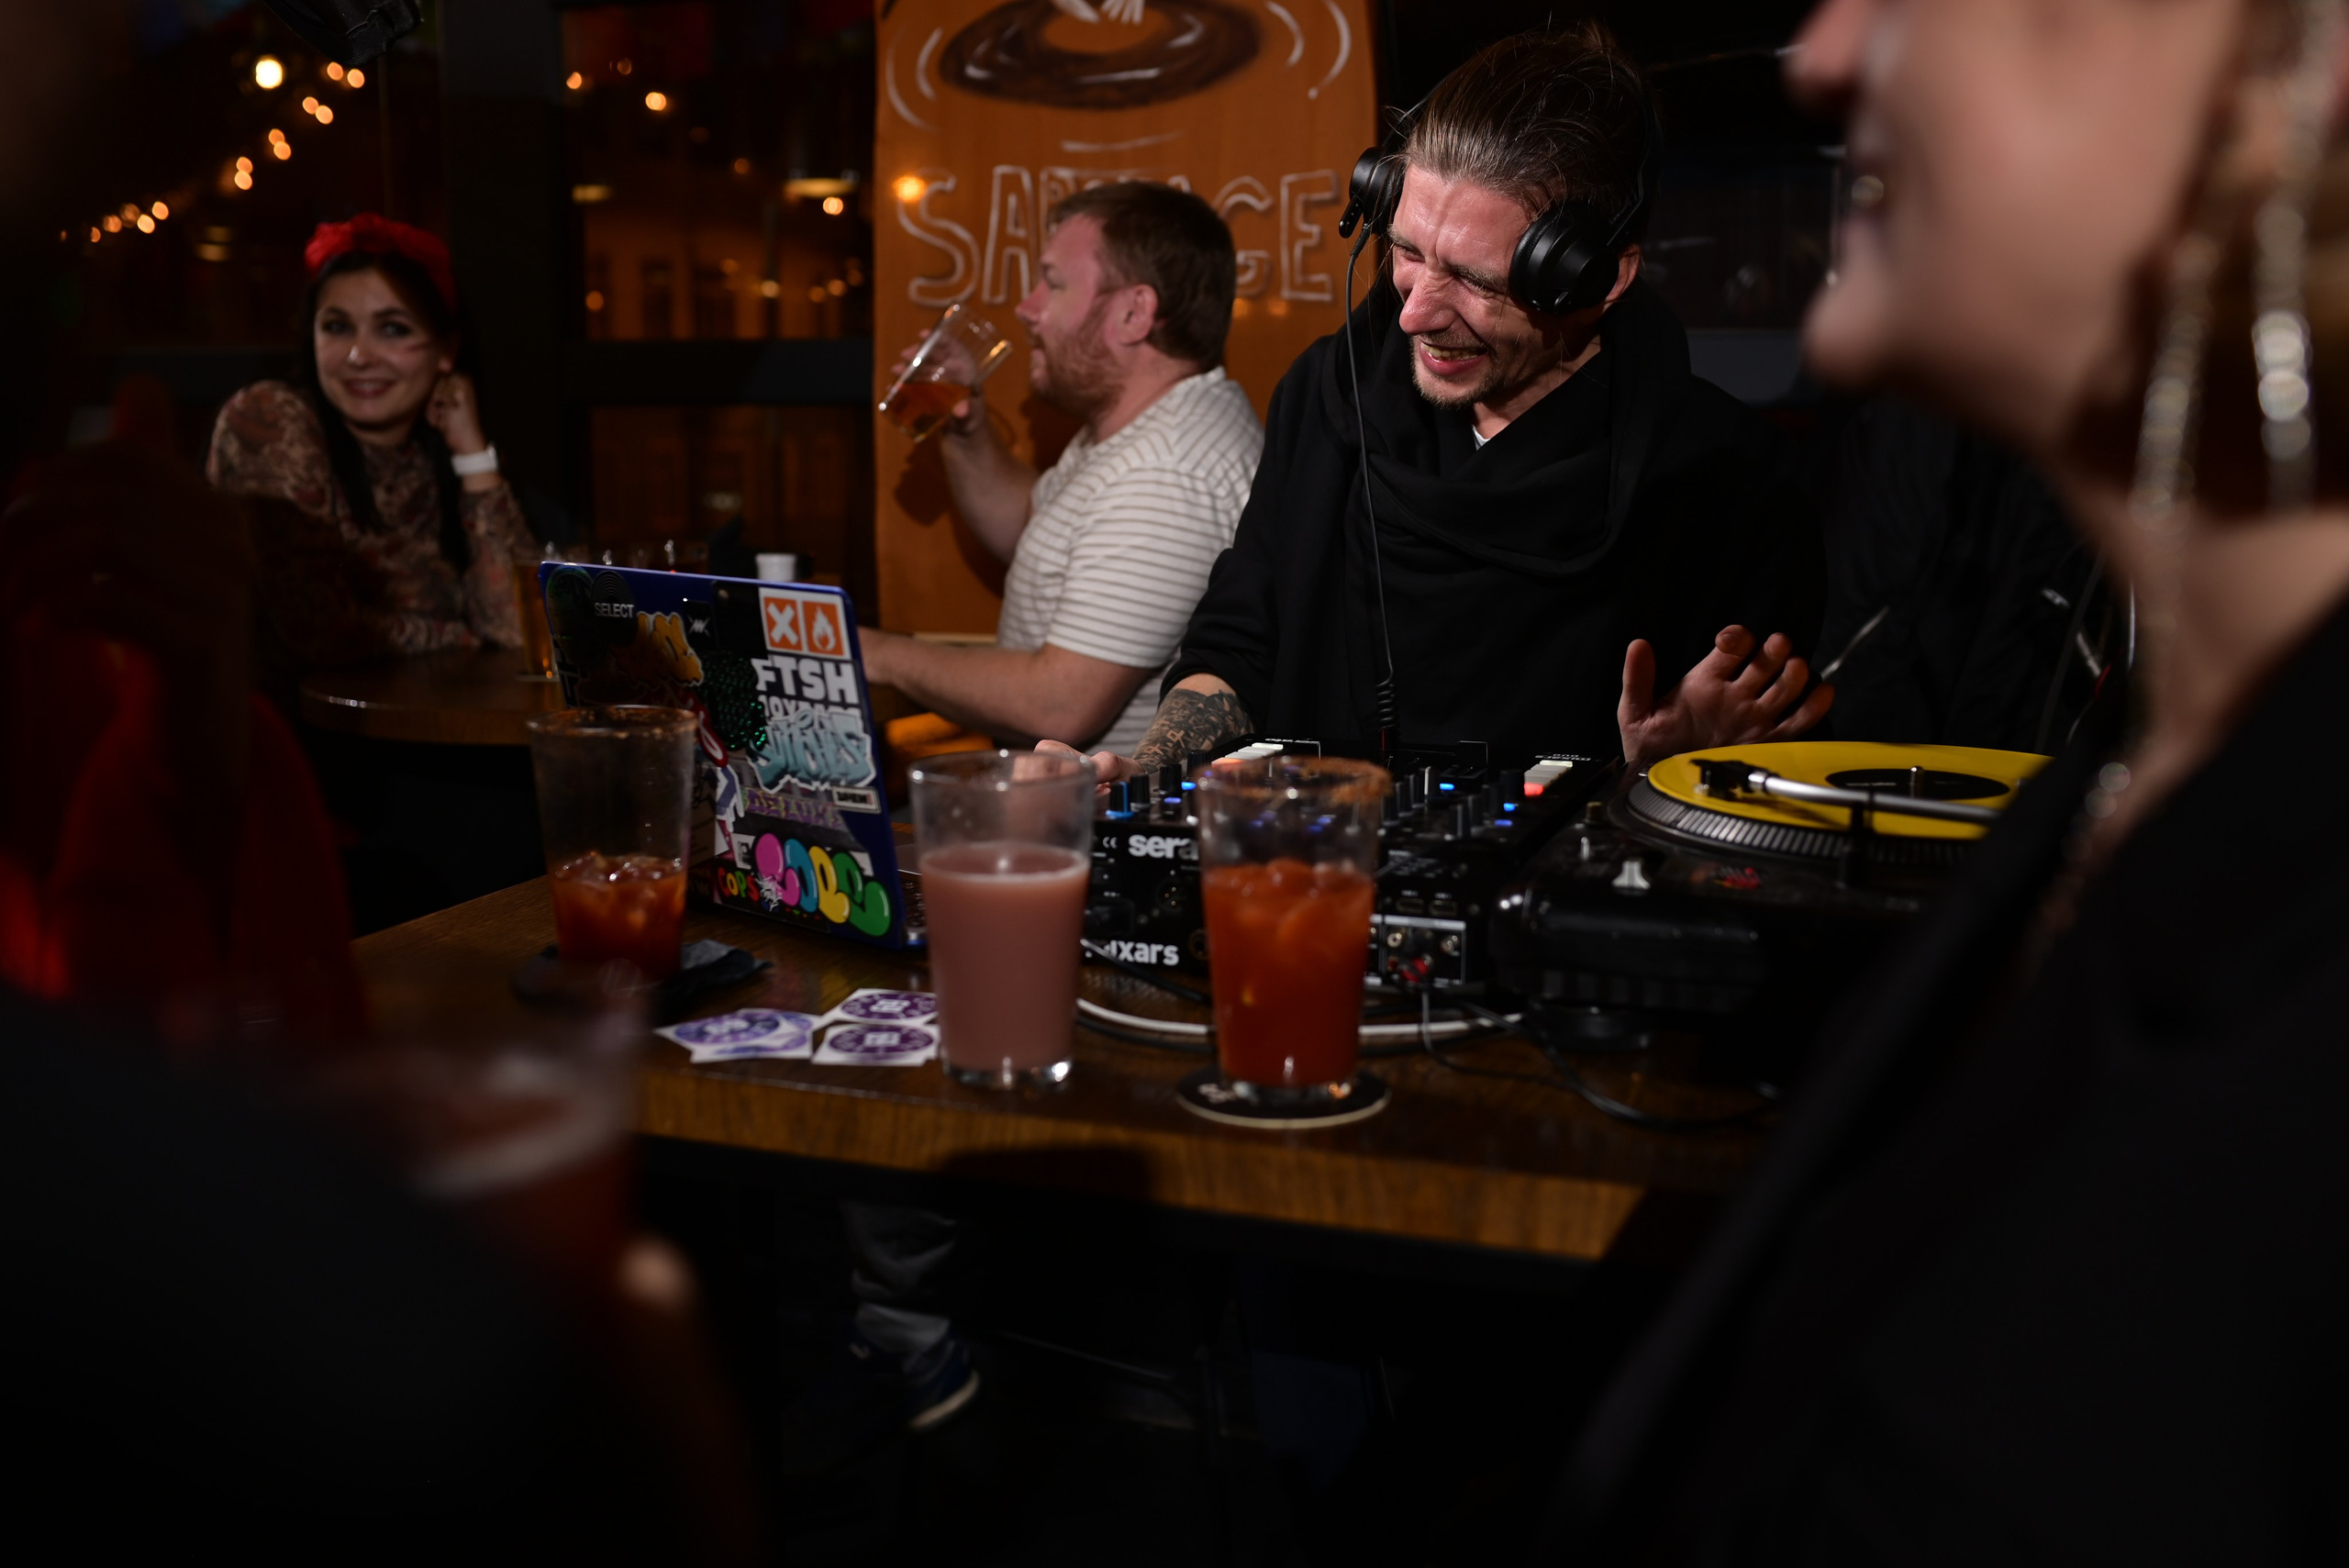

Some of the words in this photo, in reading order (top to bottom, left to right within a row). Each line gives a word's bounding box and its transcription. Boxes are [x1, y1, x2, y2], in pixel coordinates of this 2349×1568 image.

[897, 163, 1340, 307] SAGE
[594, 602, 635, 618] SELECT
[750, 654, 860, 705] FTSH
[1128, 833, 1200, 862] sera
